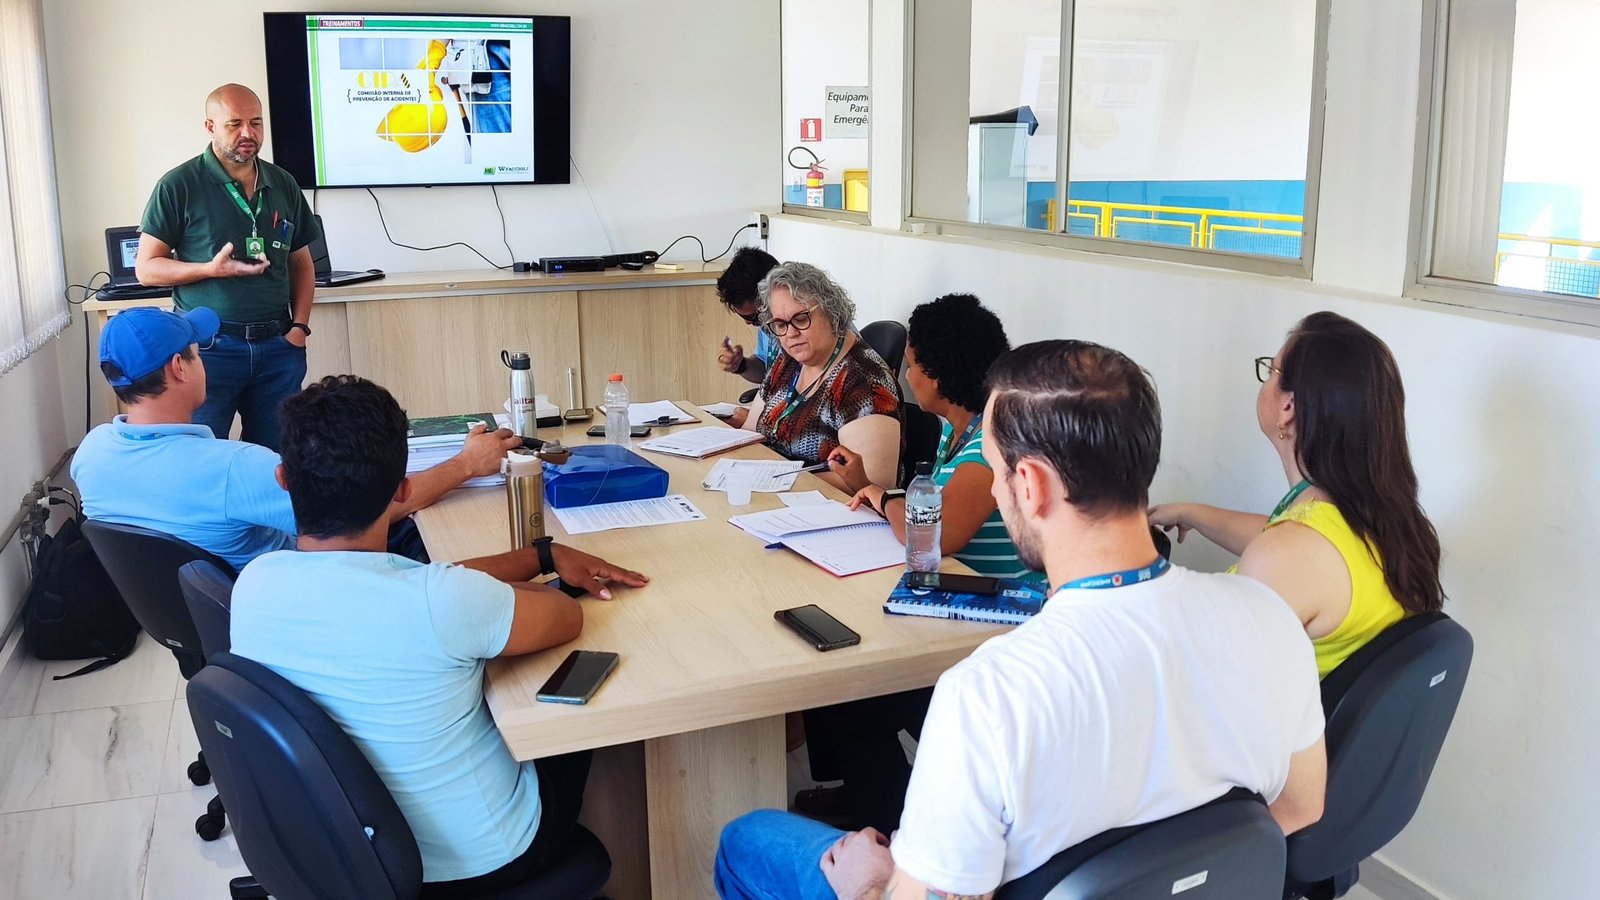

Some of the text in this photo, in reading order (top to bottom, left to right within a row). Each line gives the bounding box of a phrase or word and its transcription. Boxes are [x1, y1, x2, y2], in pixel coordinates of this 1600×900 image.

[321, 20, 361, 28] TREINAMENTOS
[849, 103, 869, 113] Para
[833, 114, 869, 126] Emergê
